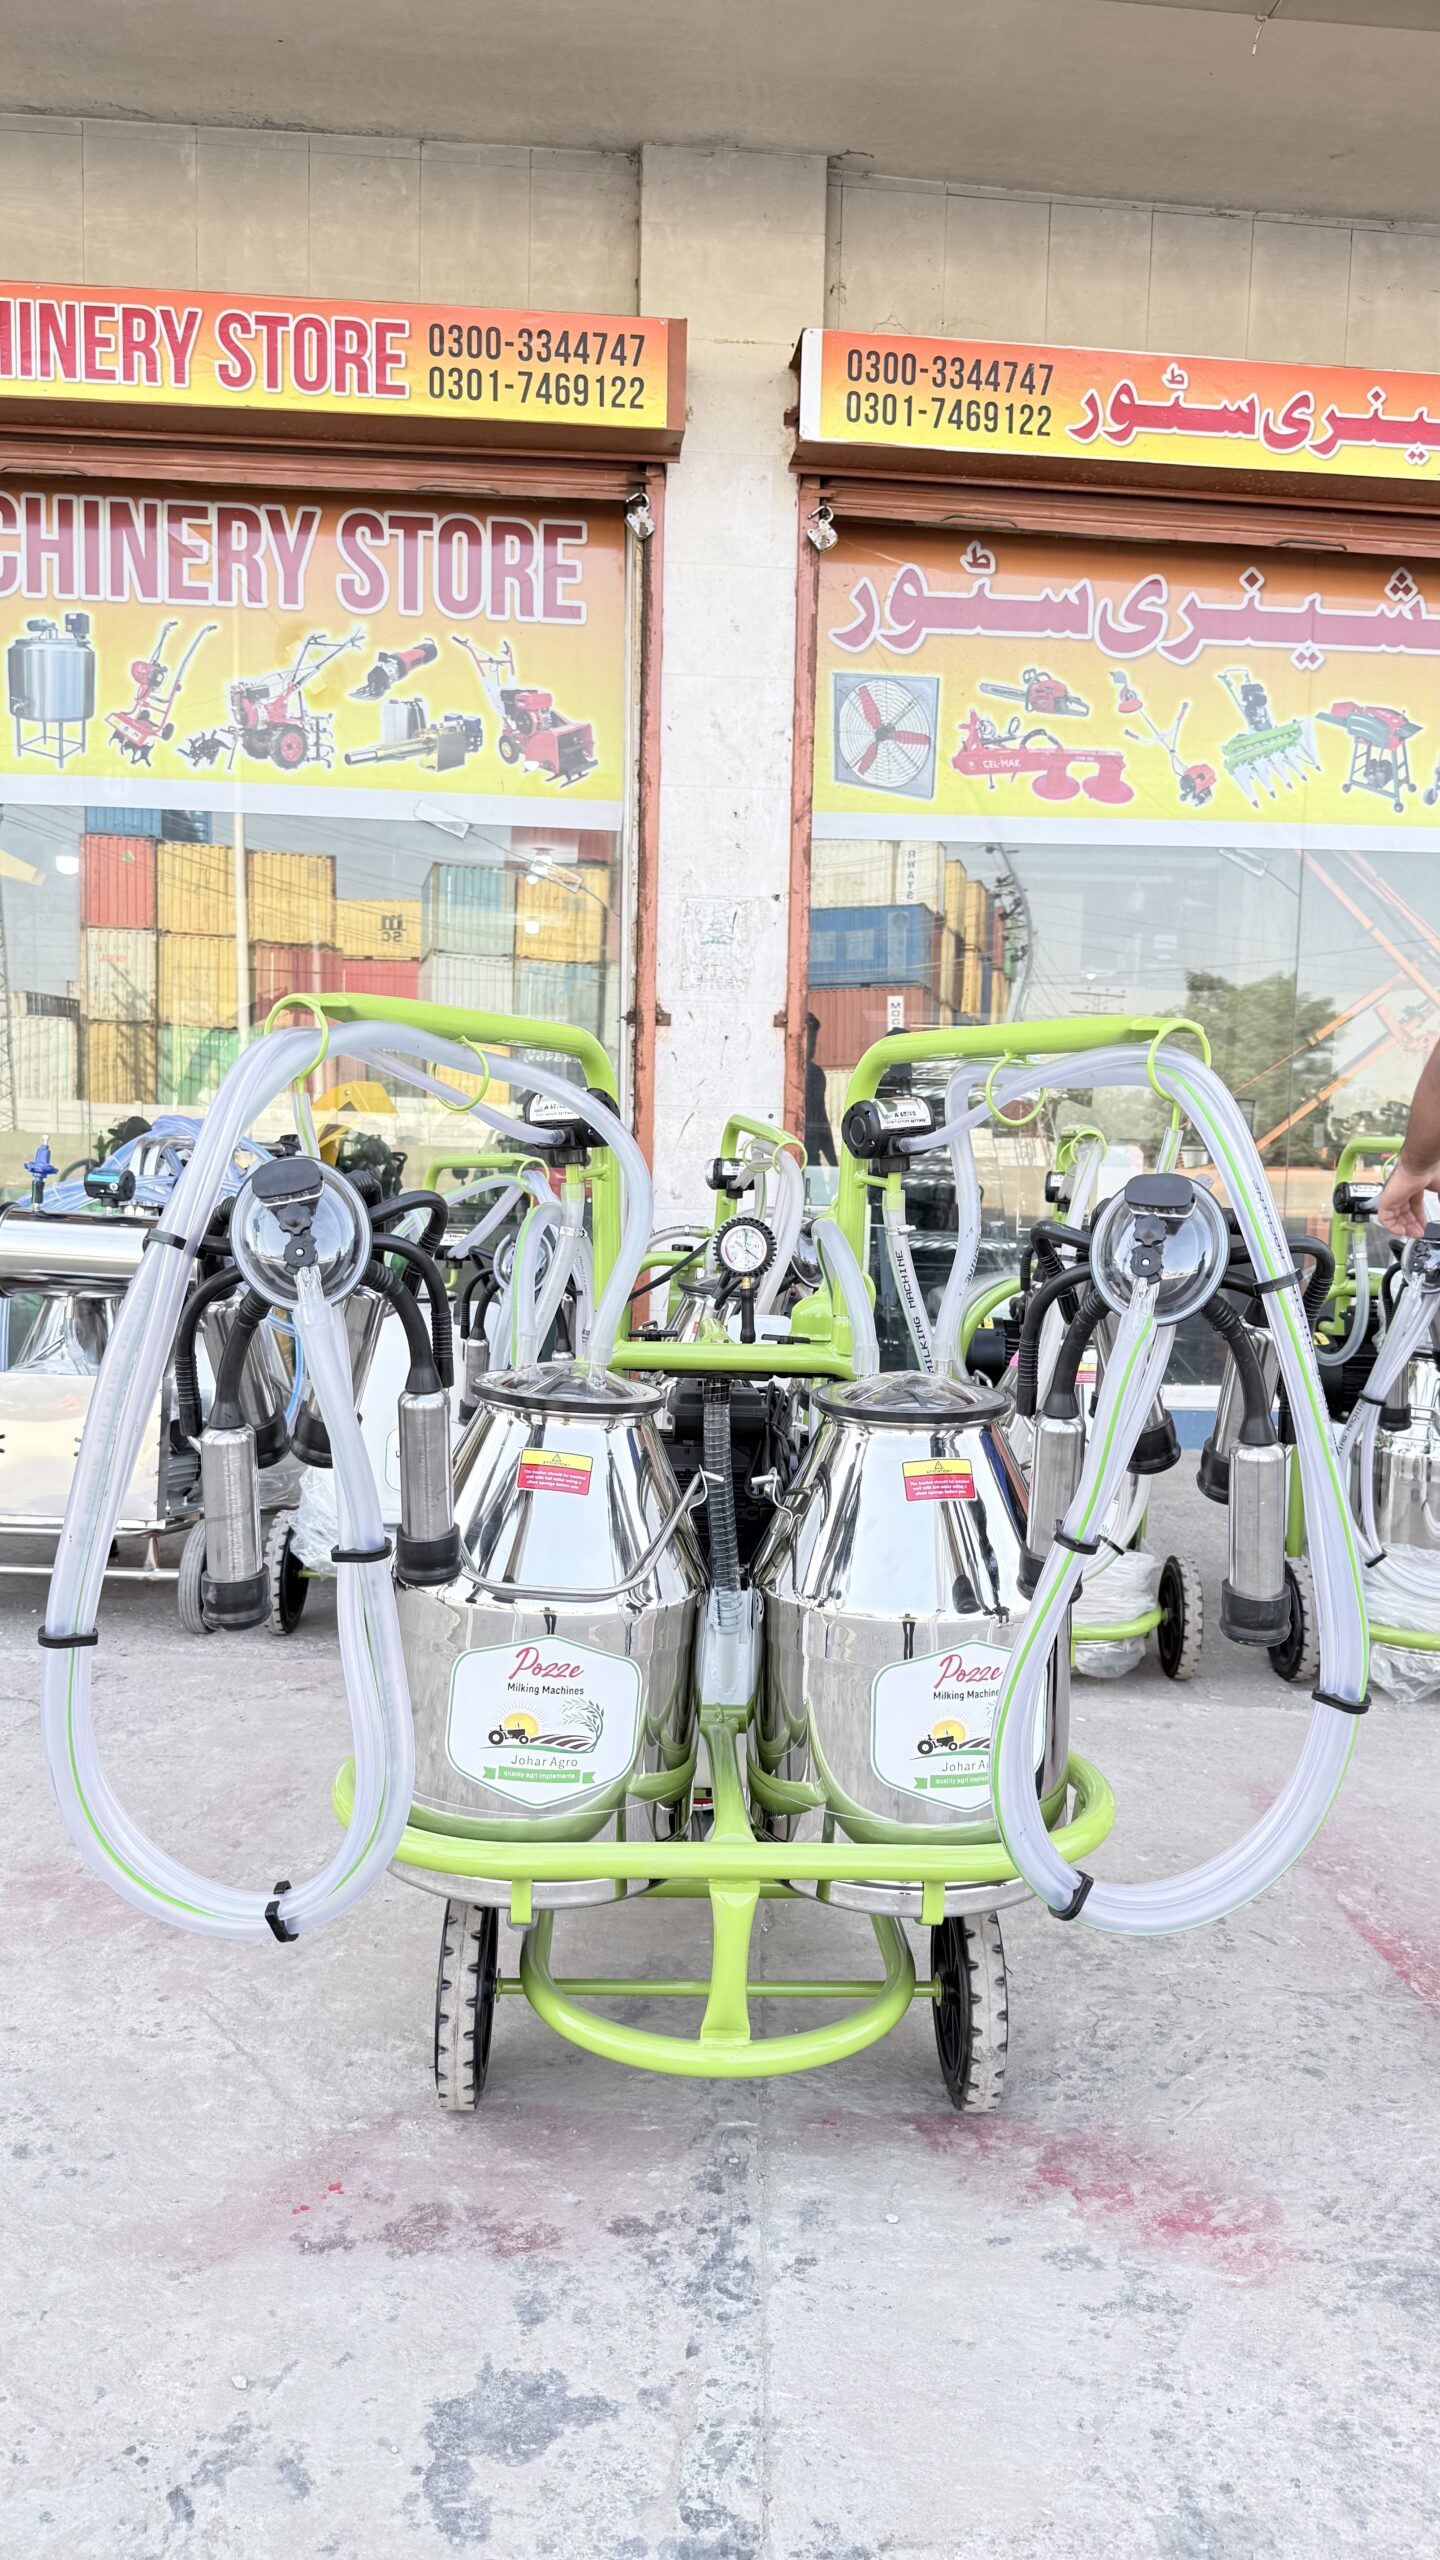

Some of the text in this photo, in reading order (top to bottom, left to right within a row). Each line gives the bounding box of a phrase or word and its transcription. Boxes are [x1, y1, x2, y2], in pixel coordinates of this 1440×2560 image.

[216, 310, 409, 397] STORE
[429, 323, 645, 367] 0300-3344747
[429, 366, 645, 410] 0301-7469122
[847, 349, 1054, 396] 0300-3344747
[846, 391, 1052, 437] 0301-7469122
[1066, 364, 1440, 464] ینری سٹور
[337, 509, 588, 624] STORE
[831, 541, 1440, 668] شینری سٹور
[895, 1250, 935, 1374] MILKING MACHINE
[507, 1682, 584, 1696] Milking Machines
[933, 1690, 965, 1702] Milking
[511, 1754, 578, 1768] Johar Agro
[942, 1761, 976, 1772] Johar
